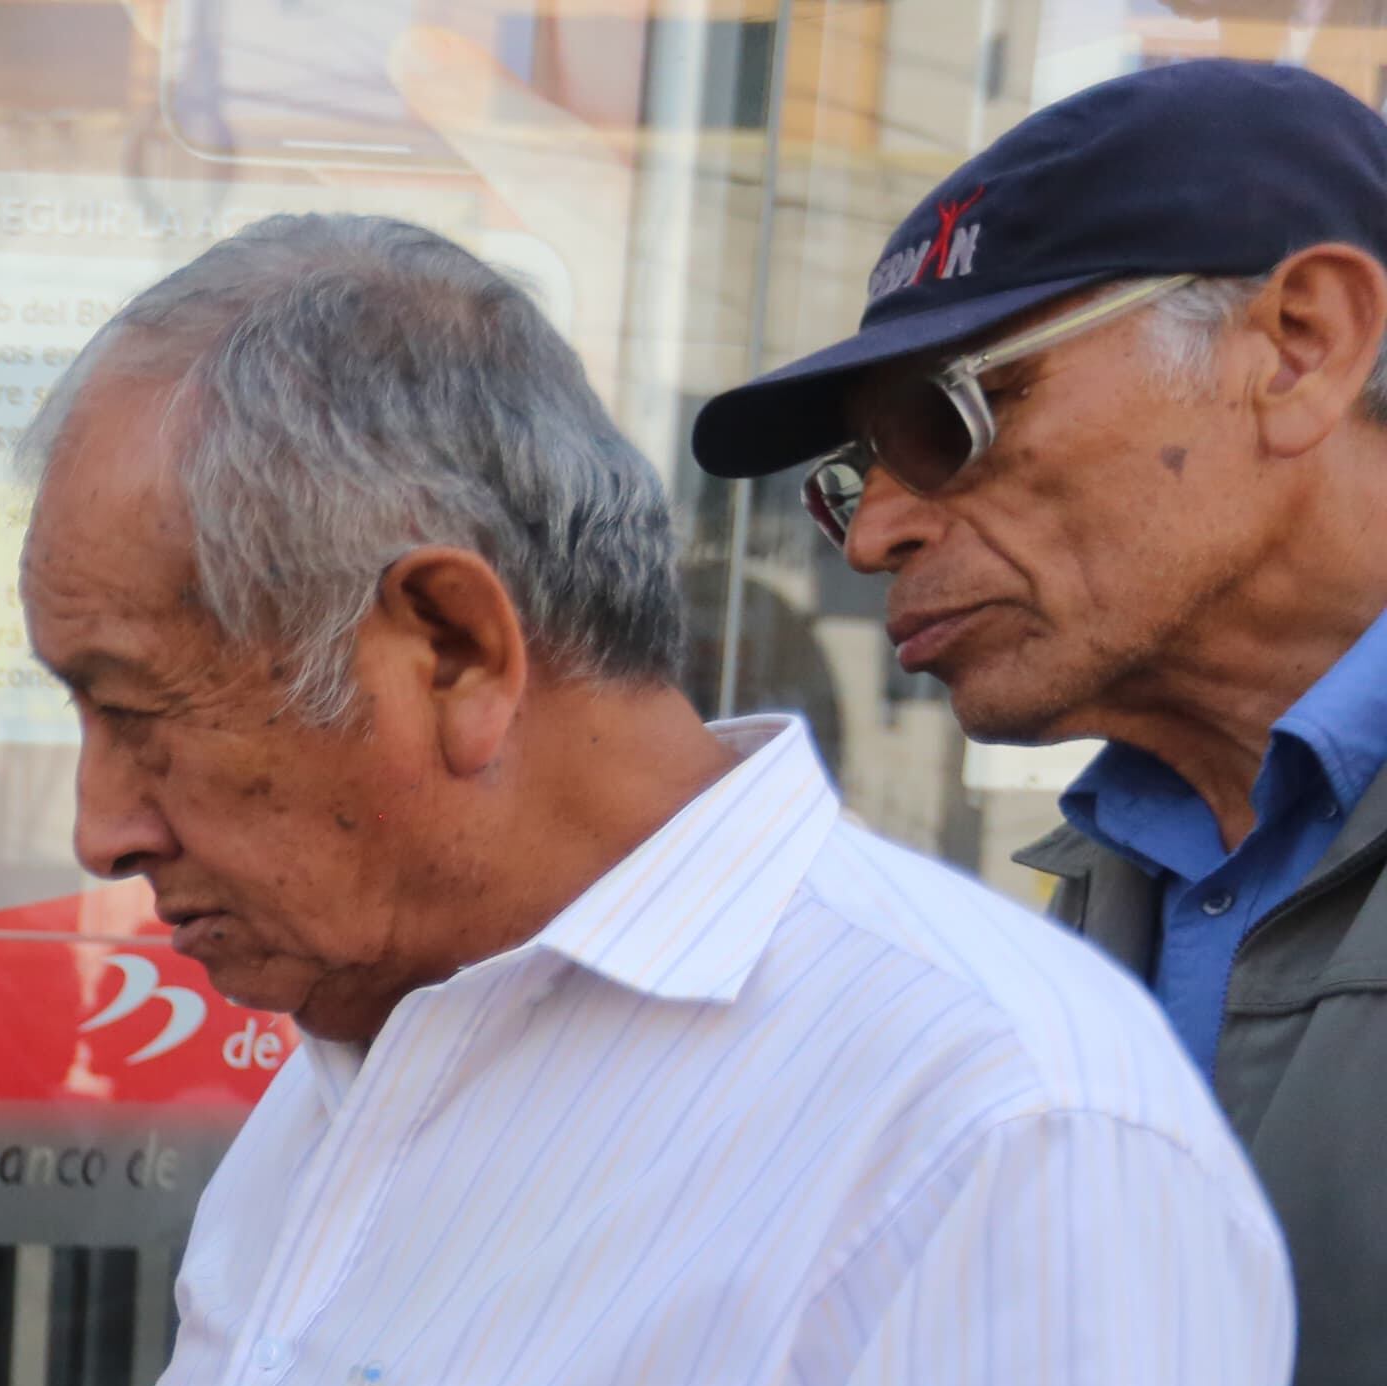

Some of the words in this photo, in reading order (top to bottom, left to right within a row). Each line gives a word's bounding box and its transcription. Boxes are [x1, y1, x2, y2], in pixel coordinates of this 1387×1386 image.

[22, 297, 67, 327] del
[223, 1017, 282, 1069] de
[128, 1128, 180, 1190] de
